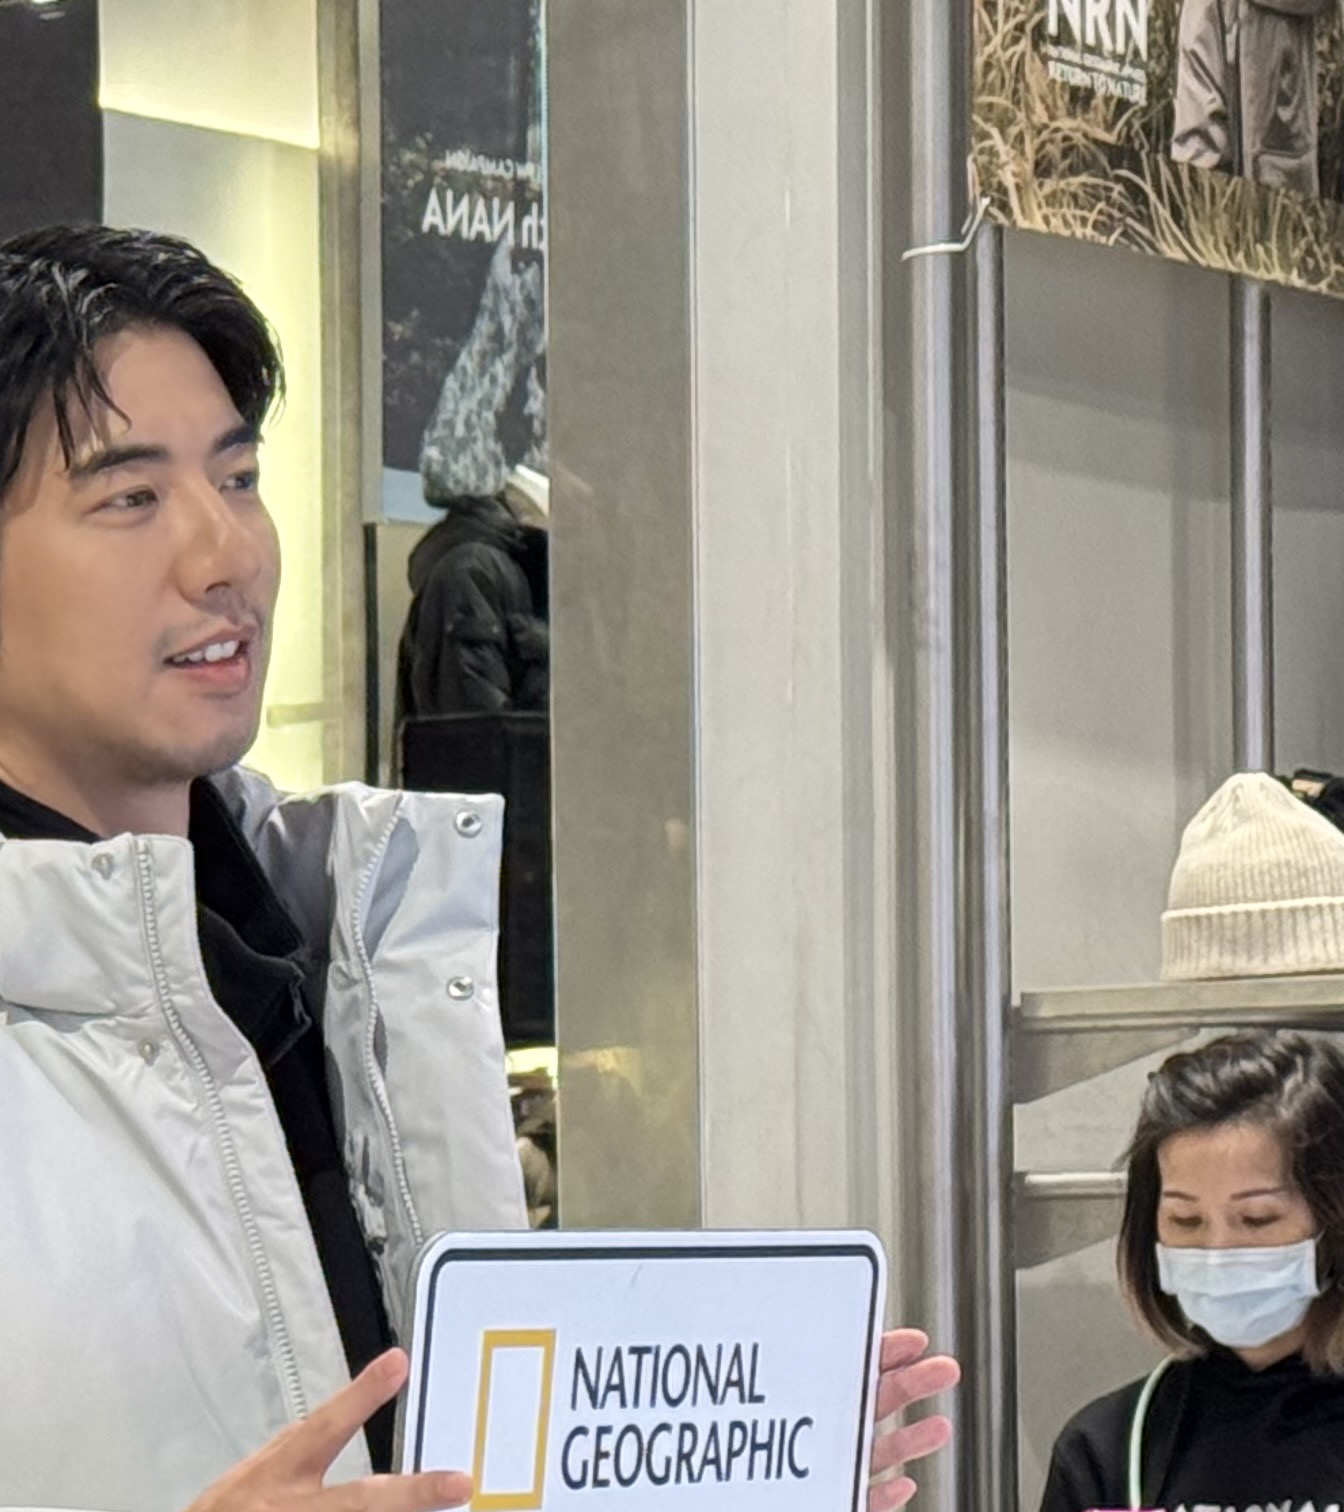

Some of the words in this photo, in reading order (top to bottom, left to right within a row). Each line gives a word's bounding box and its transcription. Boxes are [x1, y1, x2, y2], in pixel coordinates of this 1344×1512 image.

[1047, 0, 1147, 62] NRN
[570, 1342, 766, 1411] NATIONAL
[560, 1416, 814, 1490] GEOGRAPHIC
